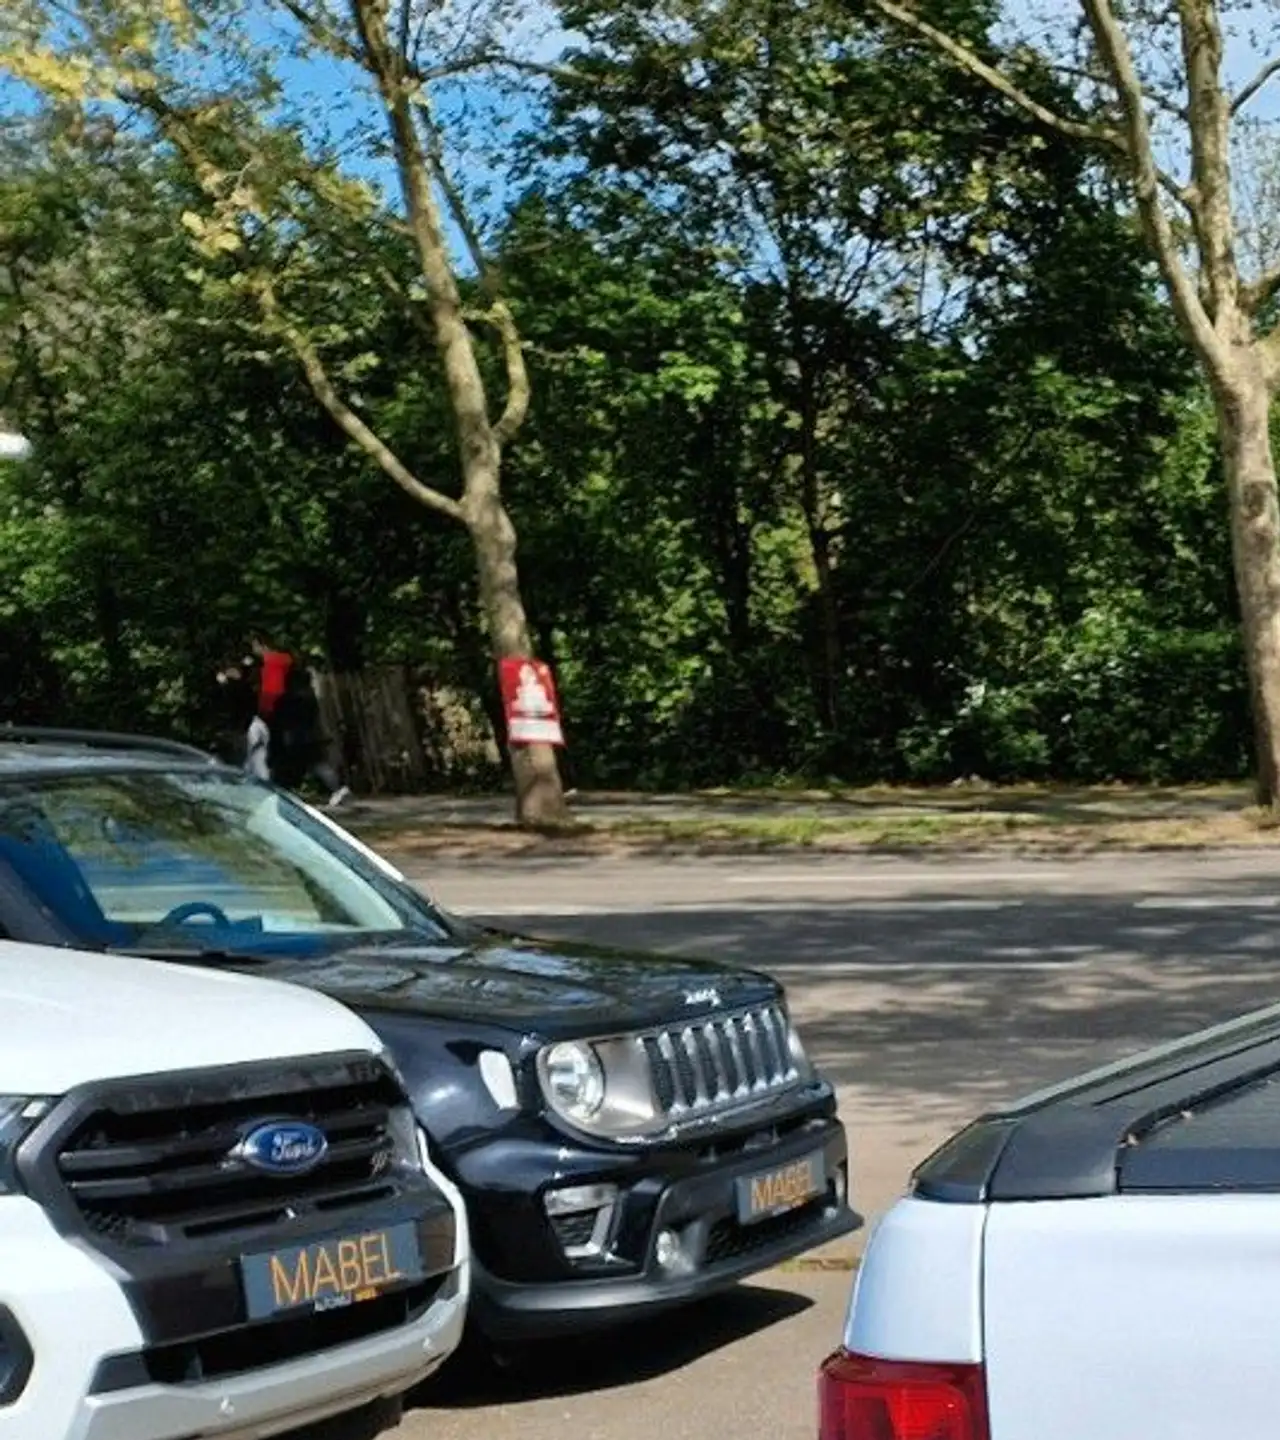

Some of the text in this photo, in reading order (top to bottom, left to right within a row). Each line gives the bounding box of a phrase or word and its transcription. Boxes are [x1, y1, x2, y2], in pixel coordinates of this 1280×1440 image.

[271, 1131, 316, 1161] Ford
[752, 1161, 817, 1209] MABEL
[270, 1232, 404, 1306] MABEL
